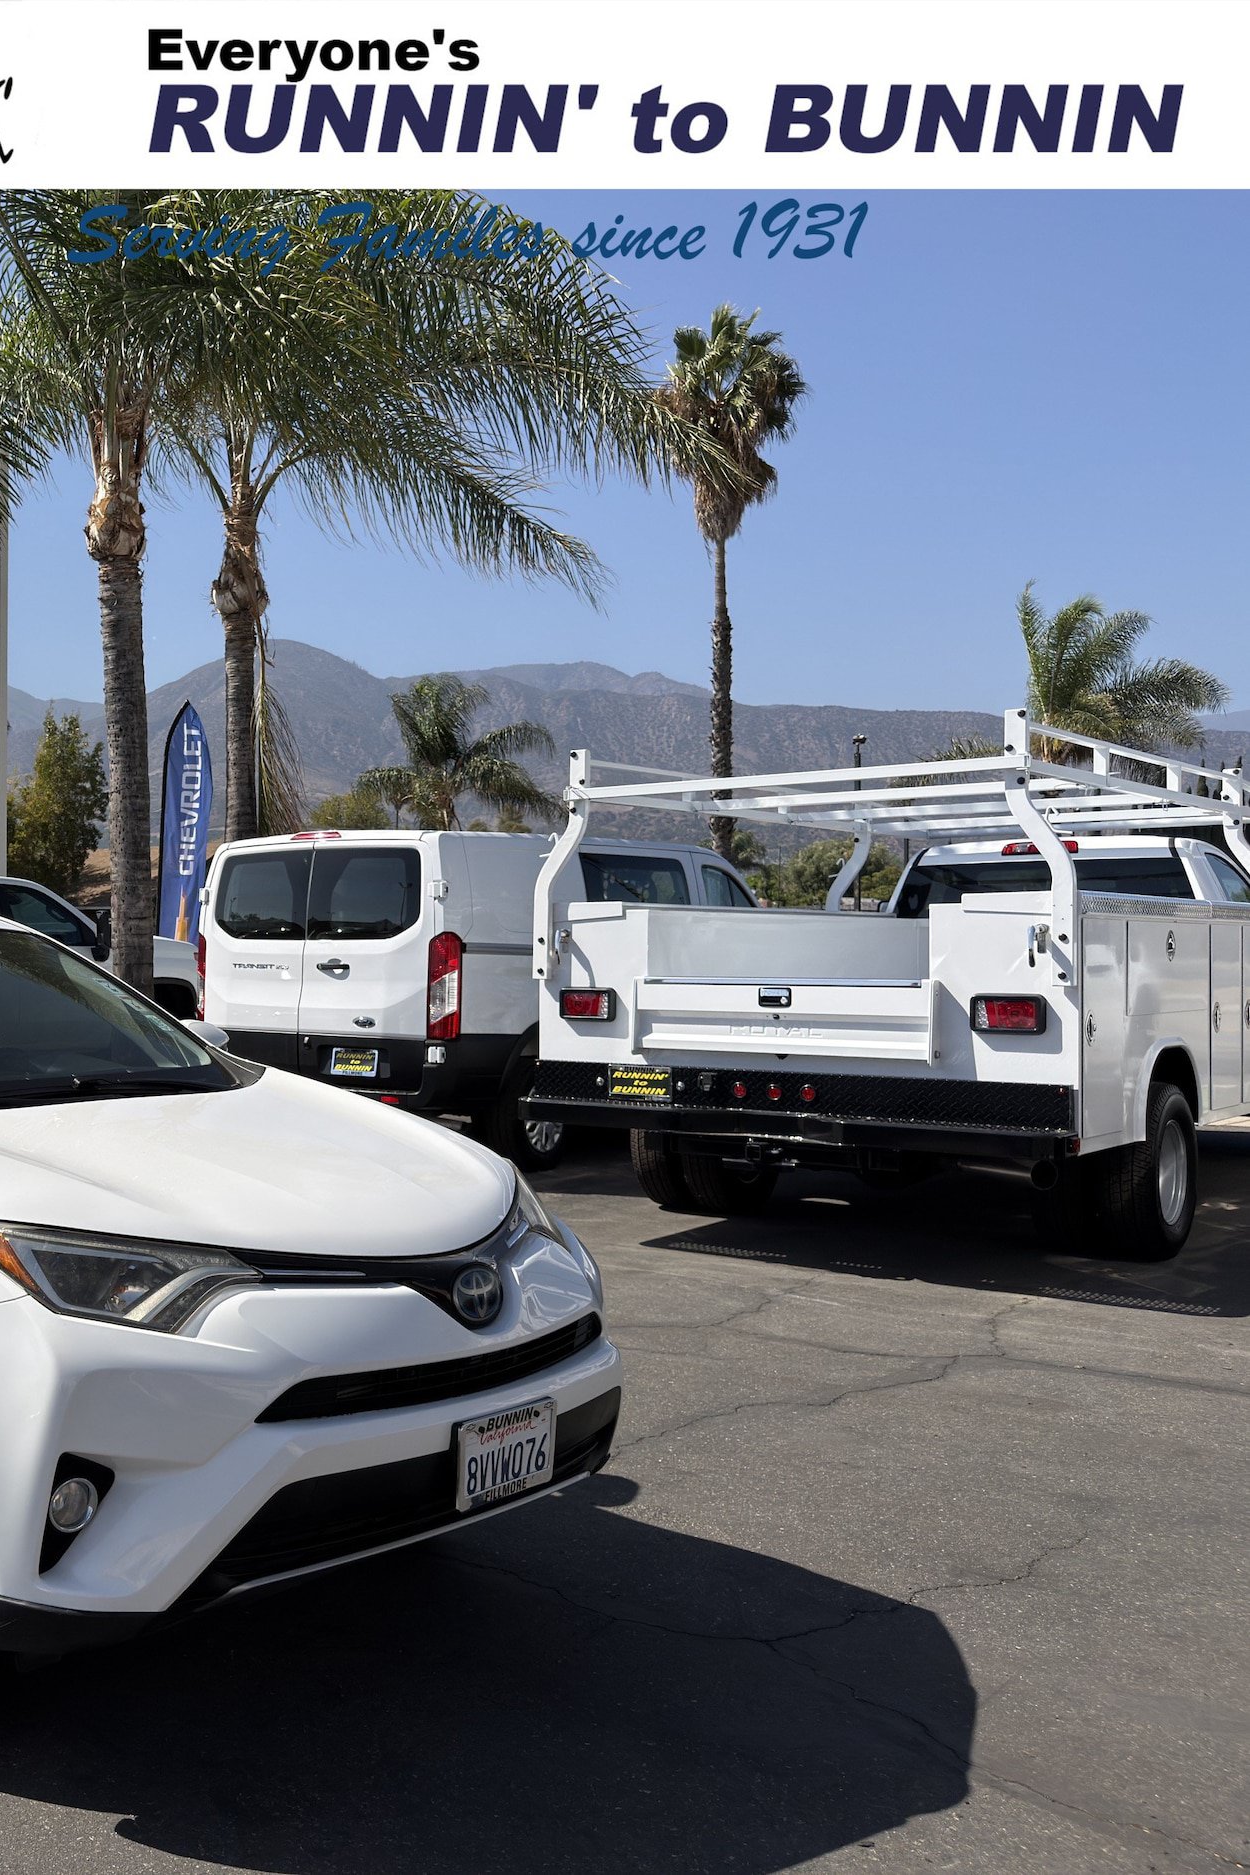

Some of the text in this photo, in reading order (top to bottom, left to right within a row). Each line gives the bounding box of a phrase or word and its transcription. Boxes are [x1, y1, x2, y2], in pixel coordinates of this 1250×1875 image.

[179, 722, 202, 876] CHEVROLET
[334, 1063, 373, 1072] BUNNIN
[612, 1071, 669, 1081] RUNNIN'
[612, 1085, 667, 1096] BUNNIN
[486, 1406, 534, 1432] BUNNIN
[467, 1432, 548, 1496] 8VVW076
[485, 1477, 528, 1502] FILLMORE
